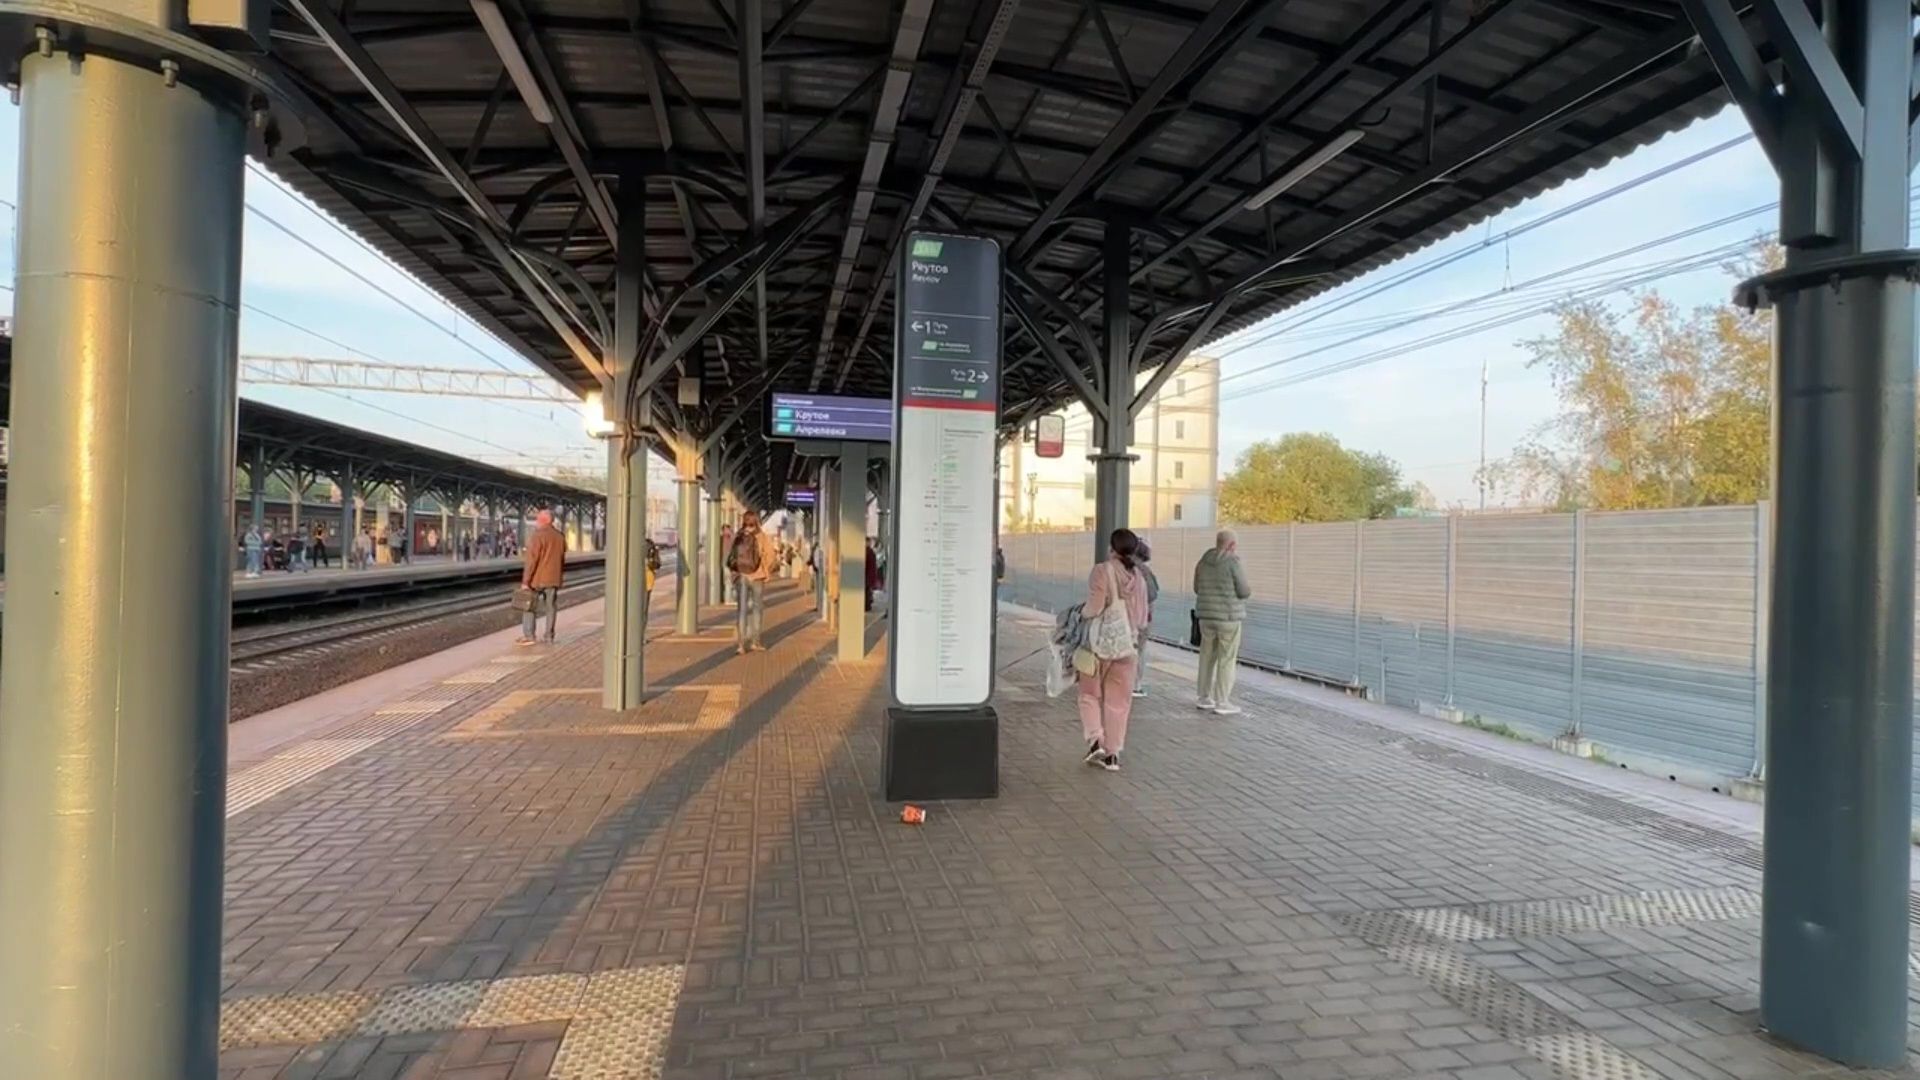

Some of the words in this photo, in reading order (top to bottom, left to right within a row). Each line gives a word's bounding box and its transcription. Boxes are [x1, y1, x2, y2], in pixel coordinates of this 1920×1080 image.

[912, 260, 949, 274] Реутов
[925, 320, 931, 334] 1
[968, 368, 976, 383] 2
